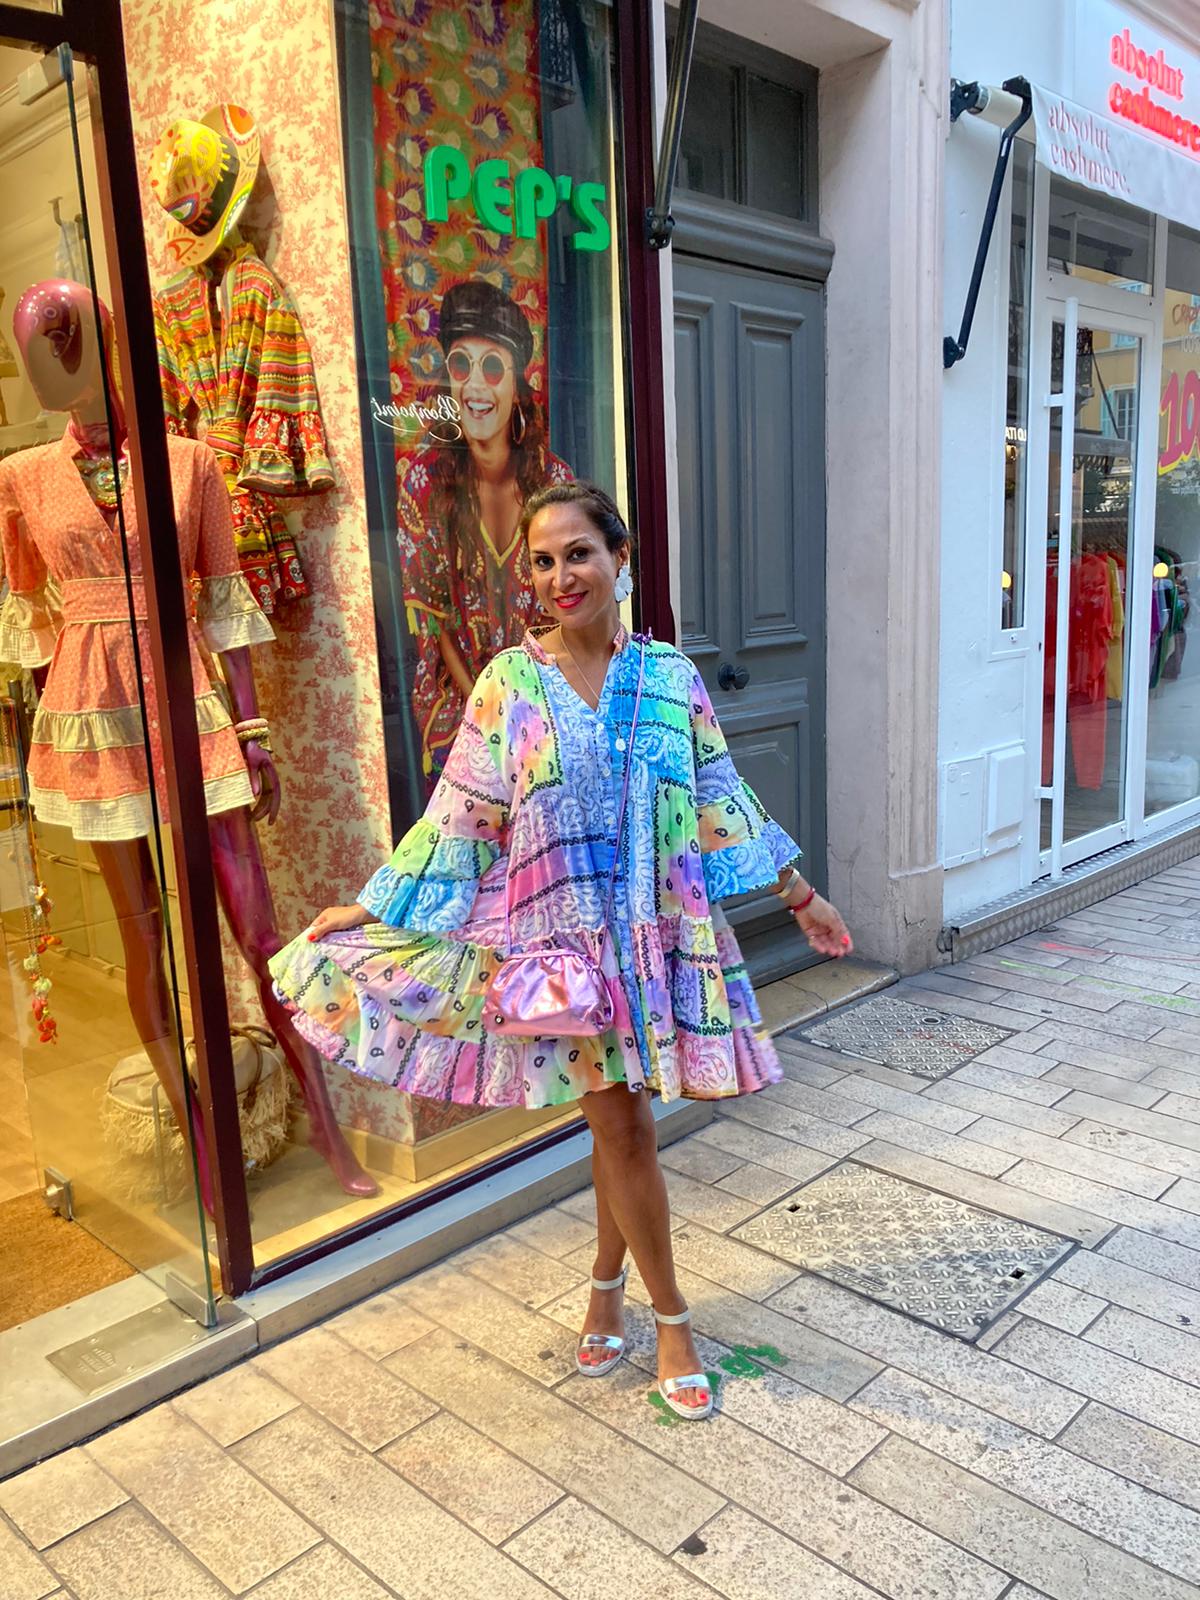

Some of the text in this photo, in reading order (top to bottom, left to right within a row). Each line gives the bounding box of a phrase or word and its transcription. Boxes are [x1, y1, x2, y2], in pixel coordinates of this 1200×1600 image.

[1111, 28, 1184, 101] absolut
[1049, 101, 1111, 154] absolut
[424, 144, 611, 253] PEP'S
